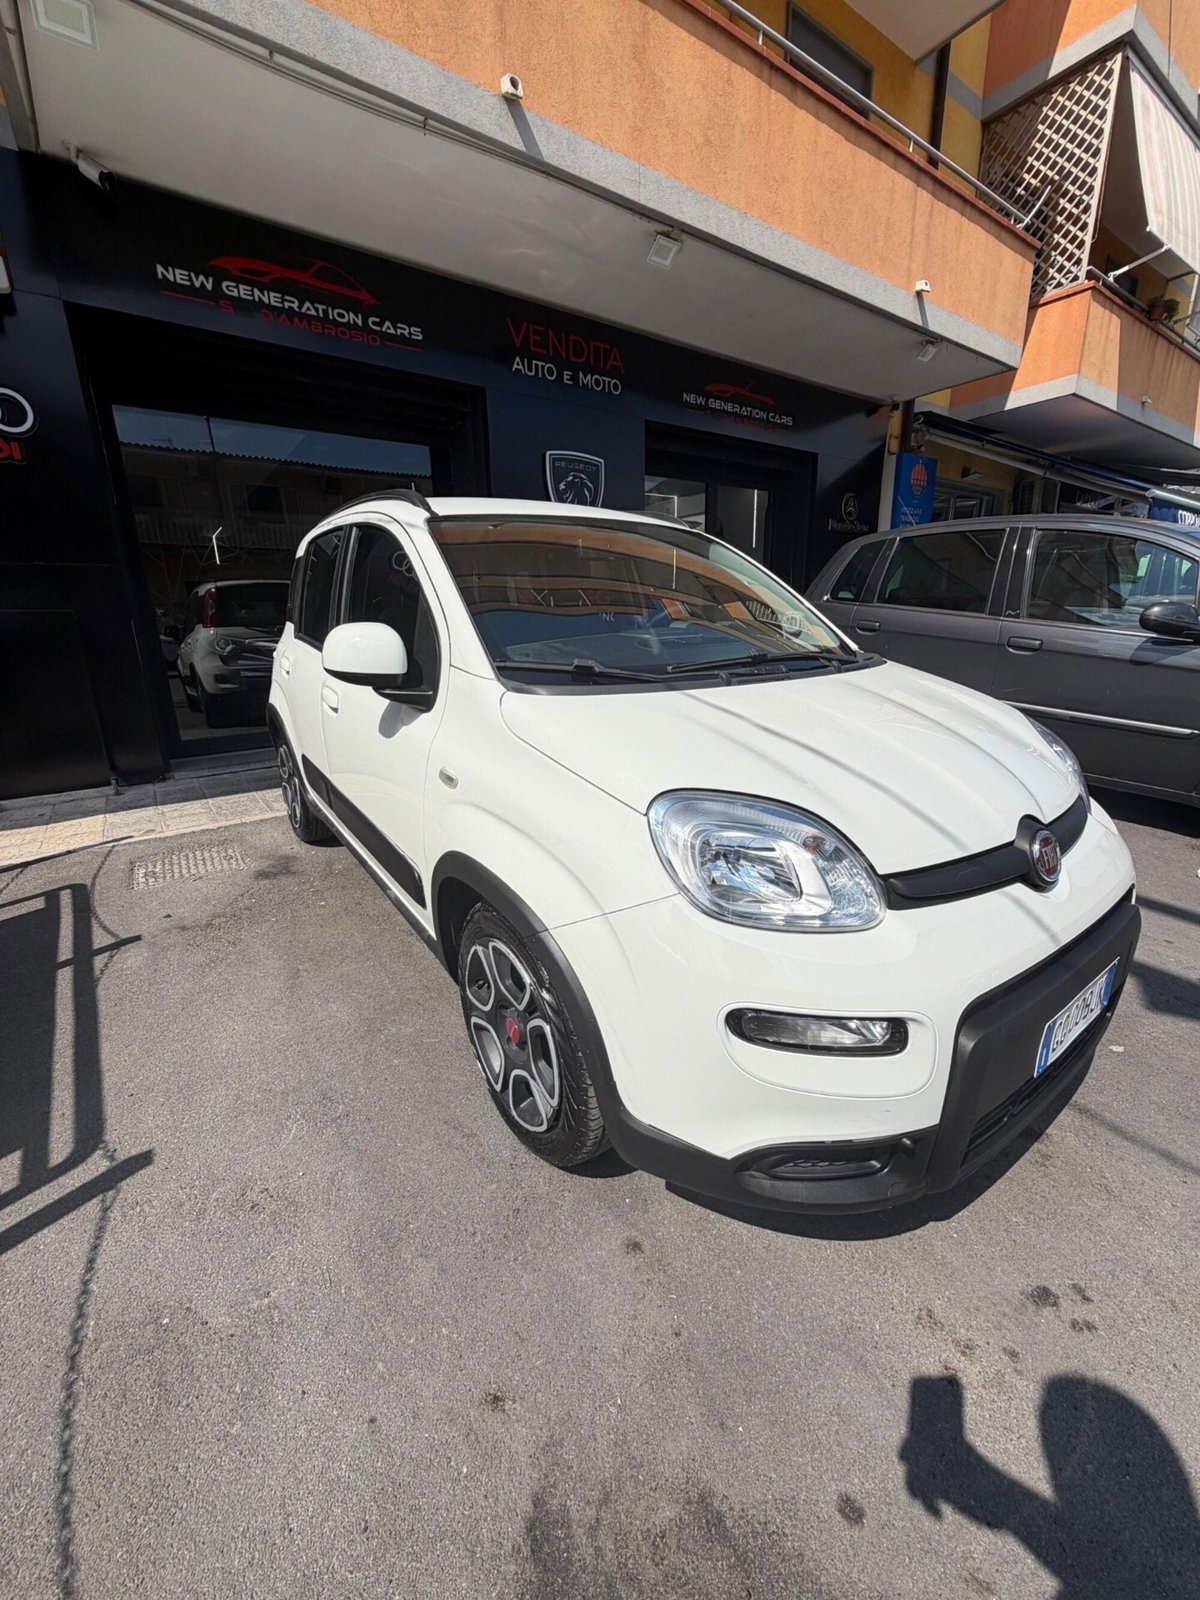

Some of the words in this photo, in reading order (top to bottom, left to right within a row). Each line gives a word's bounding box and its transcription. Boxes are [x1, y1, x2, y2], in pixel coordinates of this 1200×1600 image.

[156, 263, 213, 291] NEW
[221, 281, 363, 327] GENERATION
[368, 316, 424, 341] CARS
[506, 316, 625, 375] VENDITA
[512, 356, 557, 381] AUTO
[563, 370, 573, 384] E
[579, 371, 622, 395] MOTO
[683, 392, 706, 407] NEW
[708, 398, 768, 421] GENERATION
[768, 413, 793, 426] CARS
[554, 460, 598, 473] PEUGEOT
